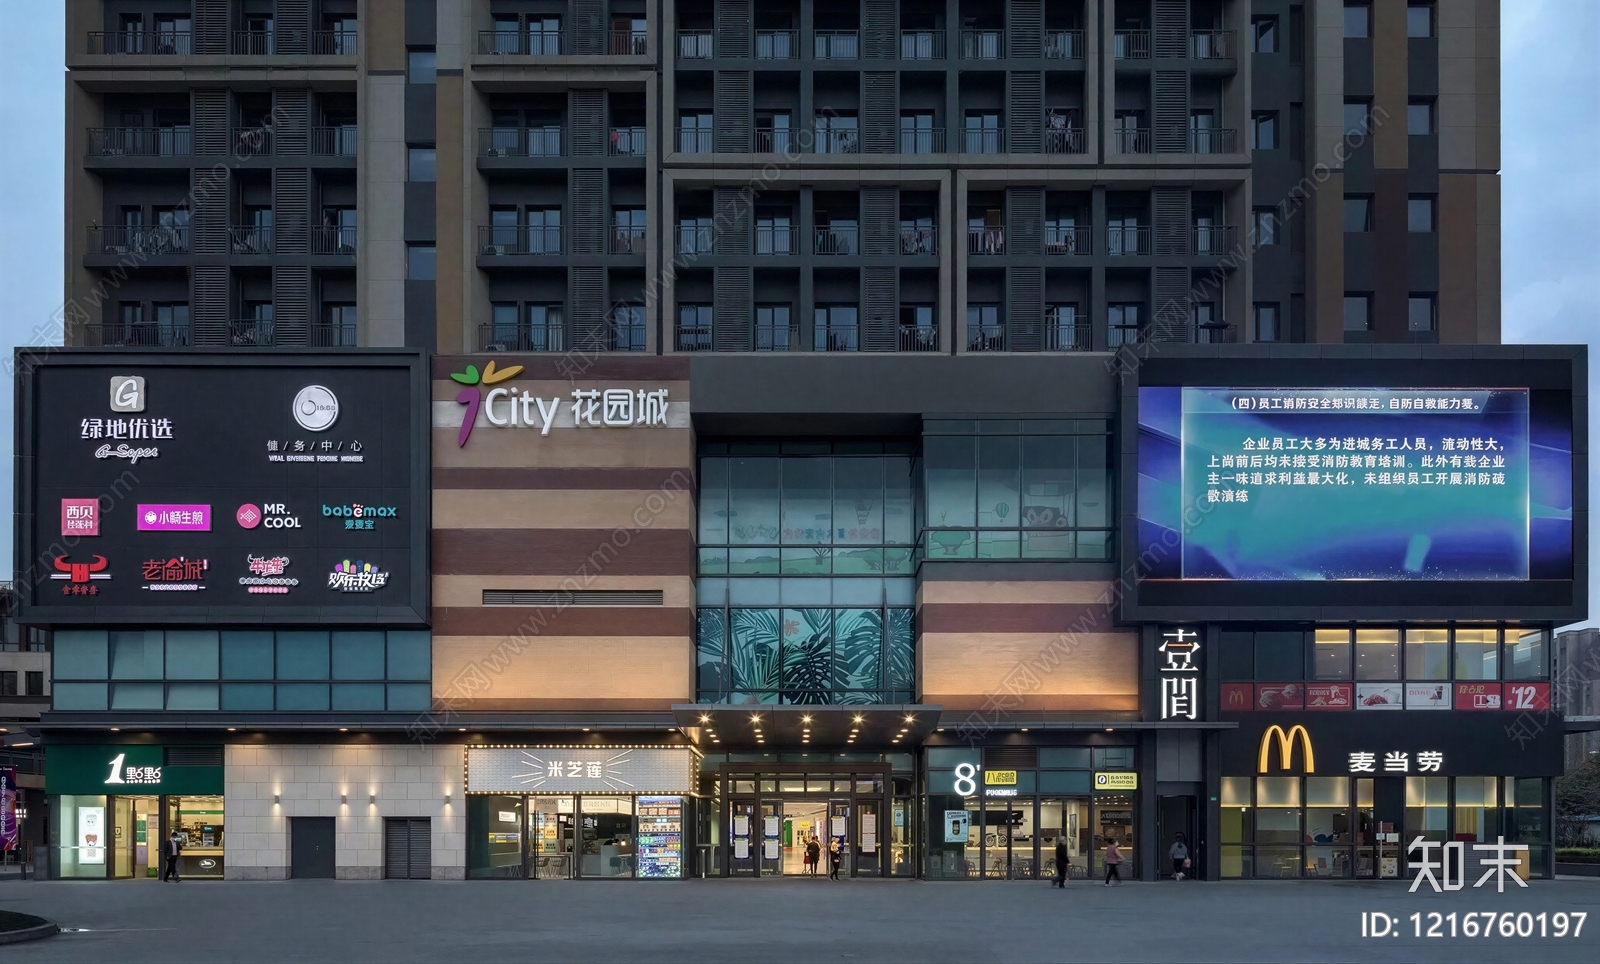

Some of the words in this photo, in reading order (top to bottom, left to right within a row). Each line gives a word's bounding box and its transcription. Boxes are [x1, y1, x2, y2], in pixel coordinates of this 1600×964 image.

[571, 388, 669, 427] 花园城
[81, 418, 174, 439] 绿地优选
[66, 505, 93, 519] 西贝
[264, 503, 291, 515] MR.
[263, 517, 302, 528] COOL
[547, 761, 602, 778] 米芝莲
[1348, 751, 1443, 773] 麦当劳
